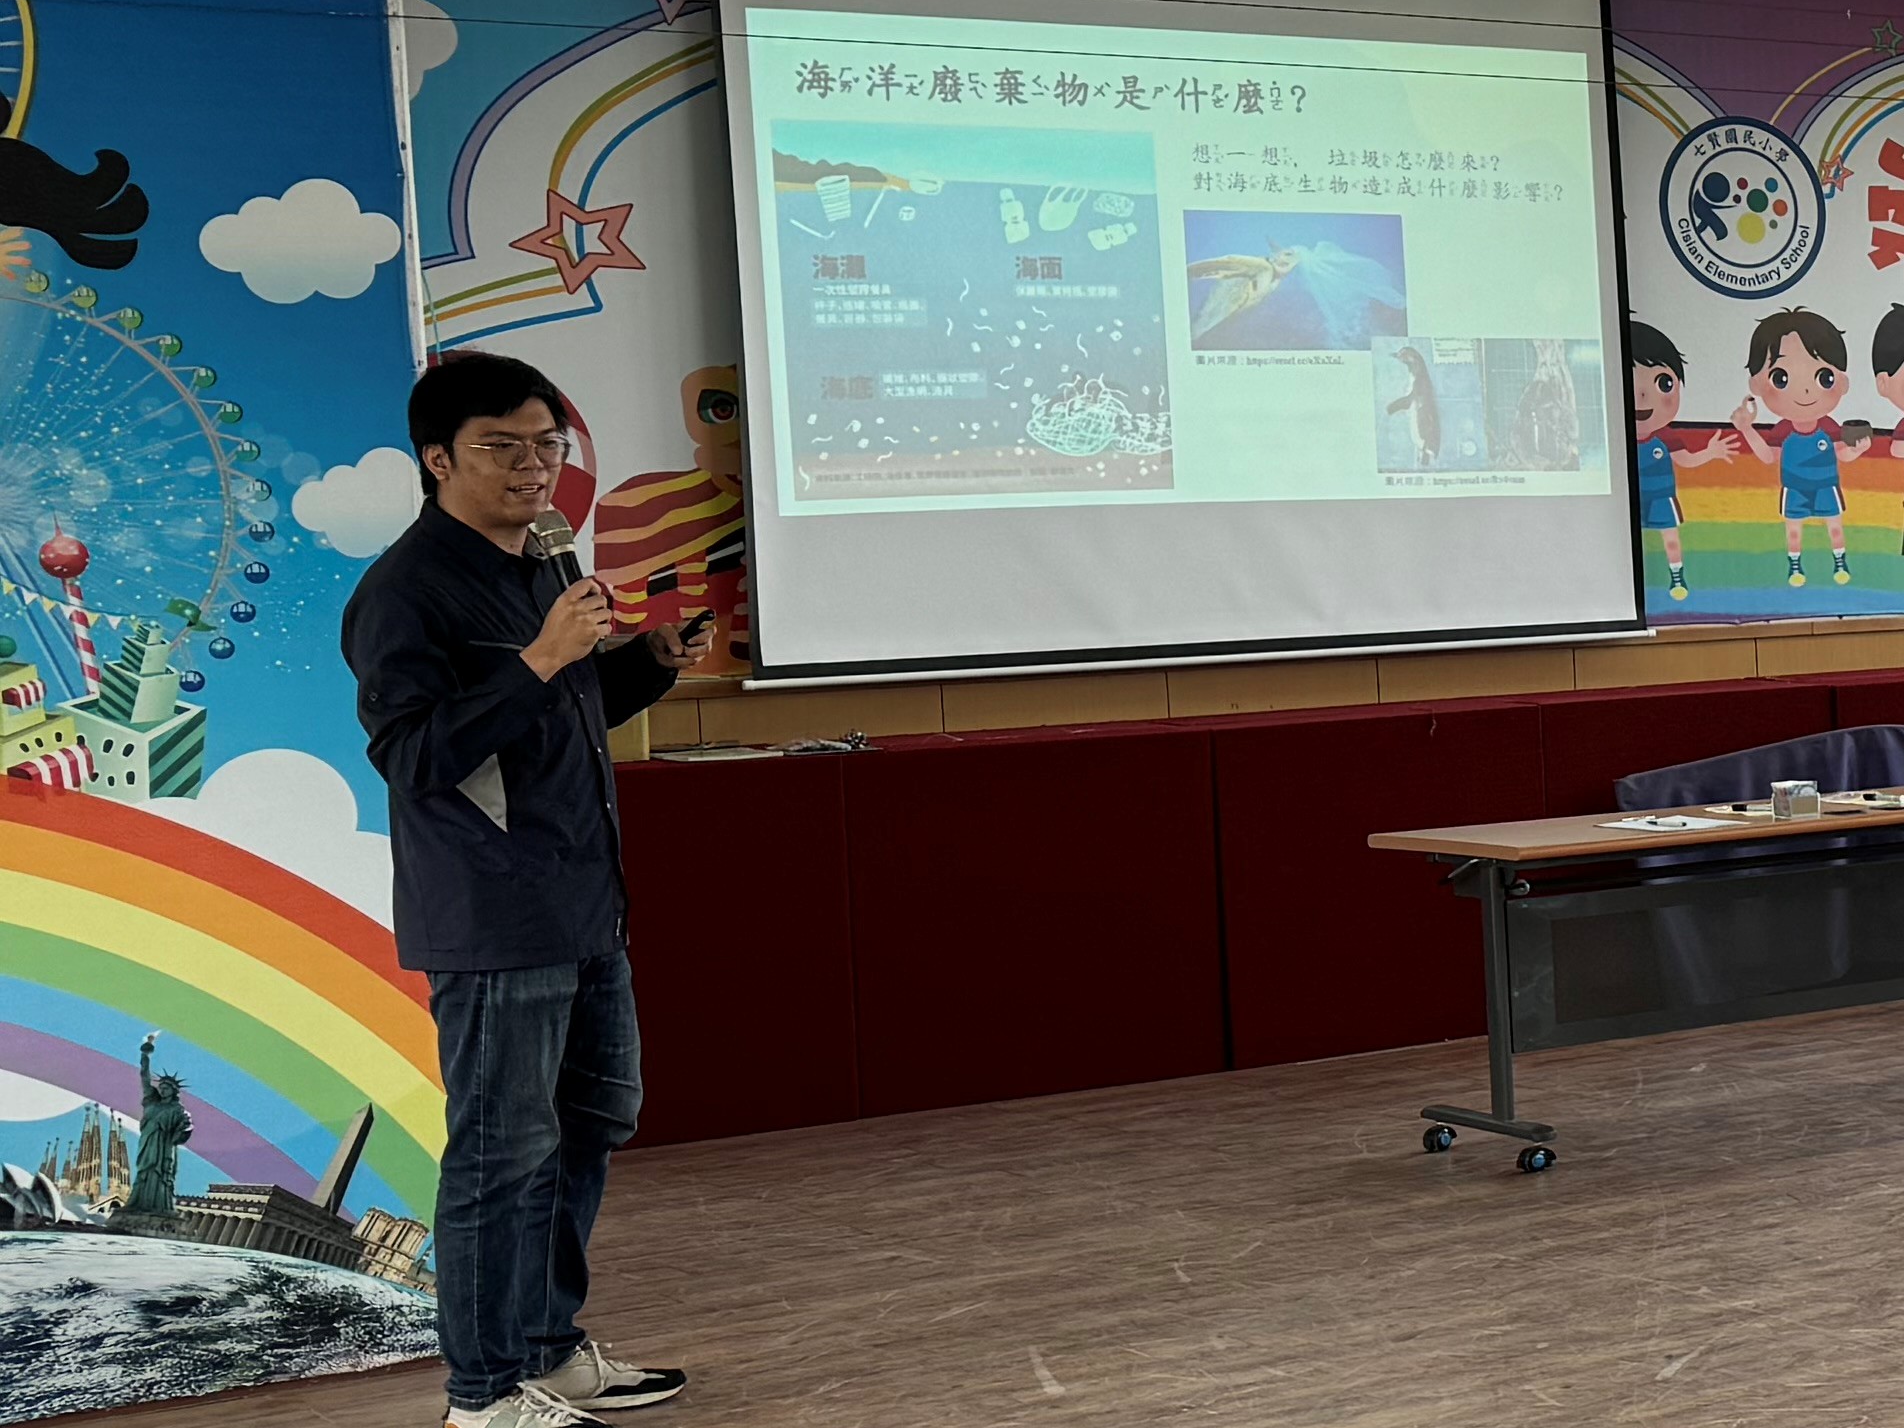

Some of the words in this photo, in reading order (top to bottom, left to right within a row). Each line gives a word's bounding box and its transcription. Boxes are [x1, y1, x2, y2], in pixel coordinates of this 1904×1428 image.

[1693, 128, 1789, 163] 七賢國民小學
[1015, 256, 1063, 280] 海面
[1678, 218, 1704, 265] Cisian
[1705, 261, 1782, 287] Elementary
[1781, 225, 1811, 270] School
